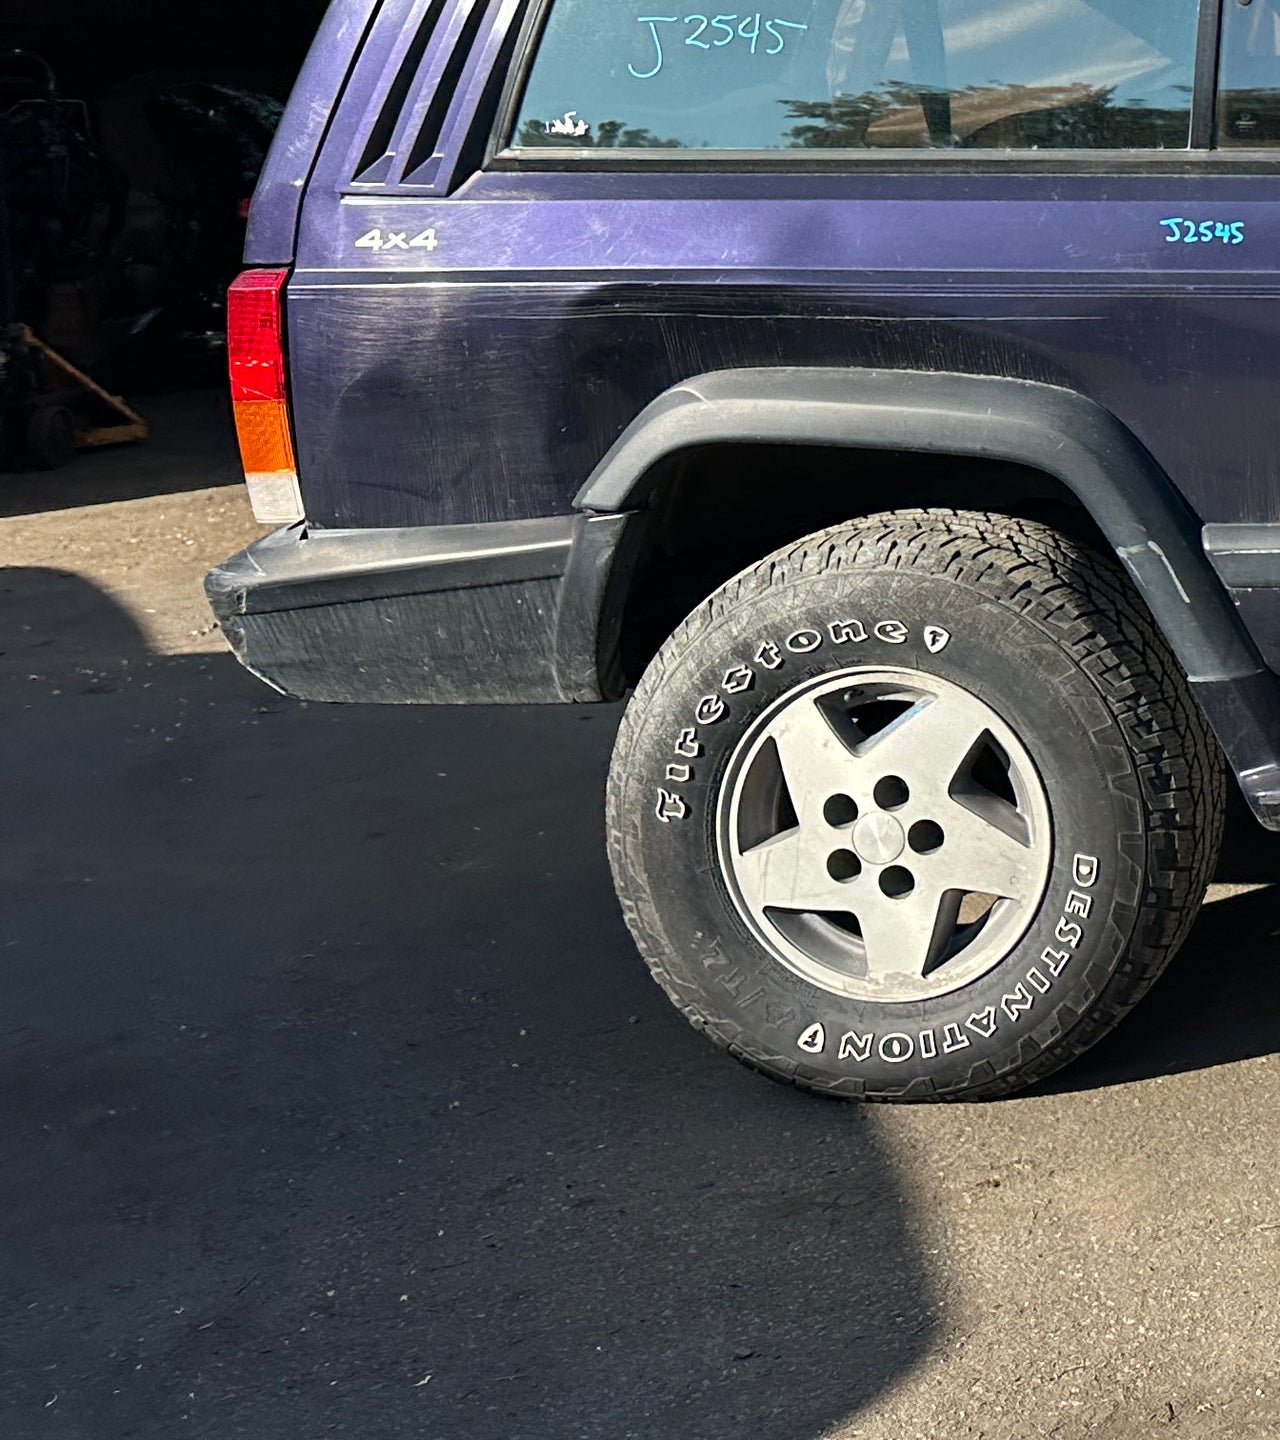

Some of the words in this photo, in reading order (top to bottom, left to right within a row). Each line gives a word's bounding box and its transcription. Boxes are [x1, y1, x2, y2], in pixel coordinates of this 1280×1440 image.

[627, 13, 808, 78] J2545
[355, 229, 438, 251] 4x4
[1159, 217, 1245, 244] J2545
[655, 618, 909, 823] Firestone
[838, 853, 1098, 1063] DESTINATION
